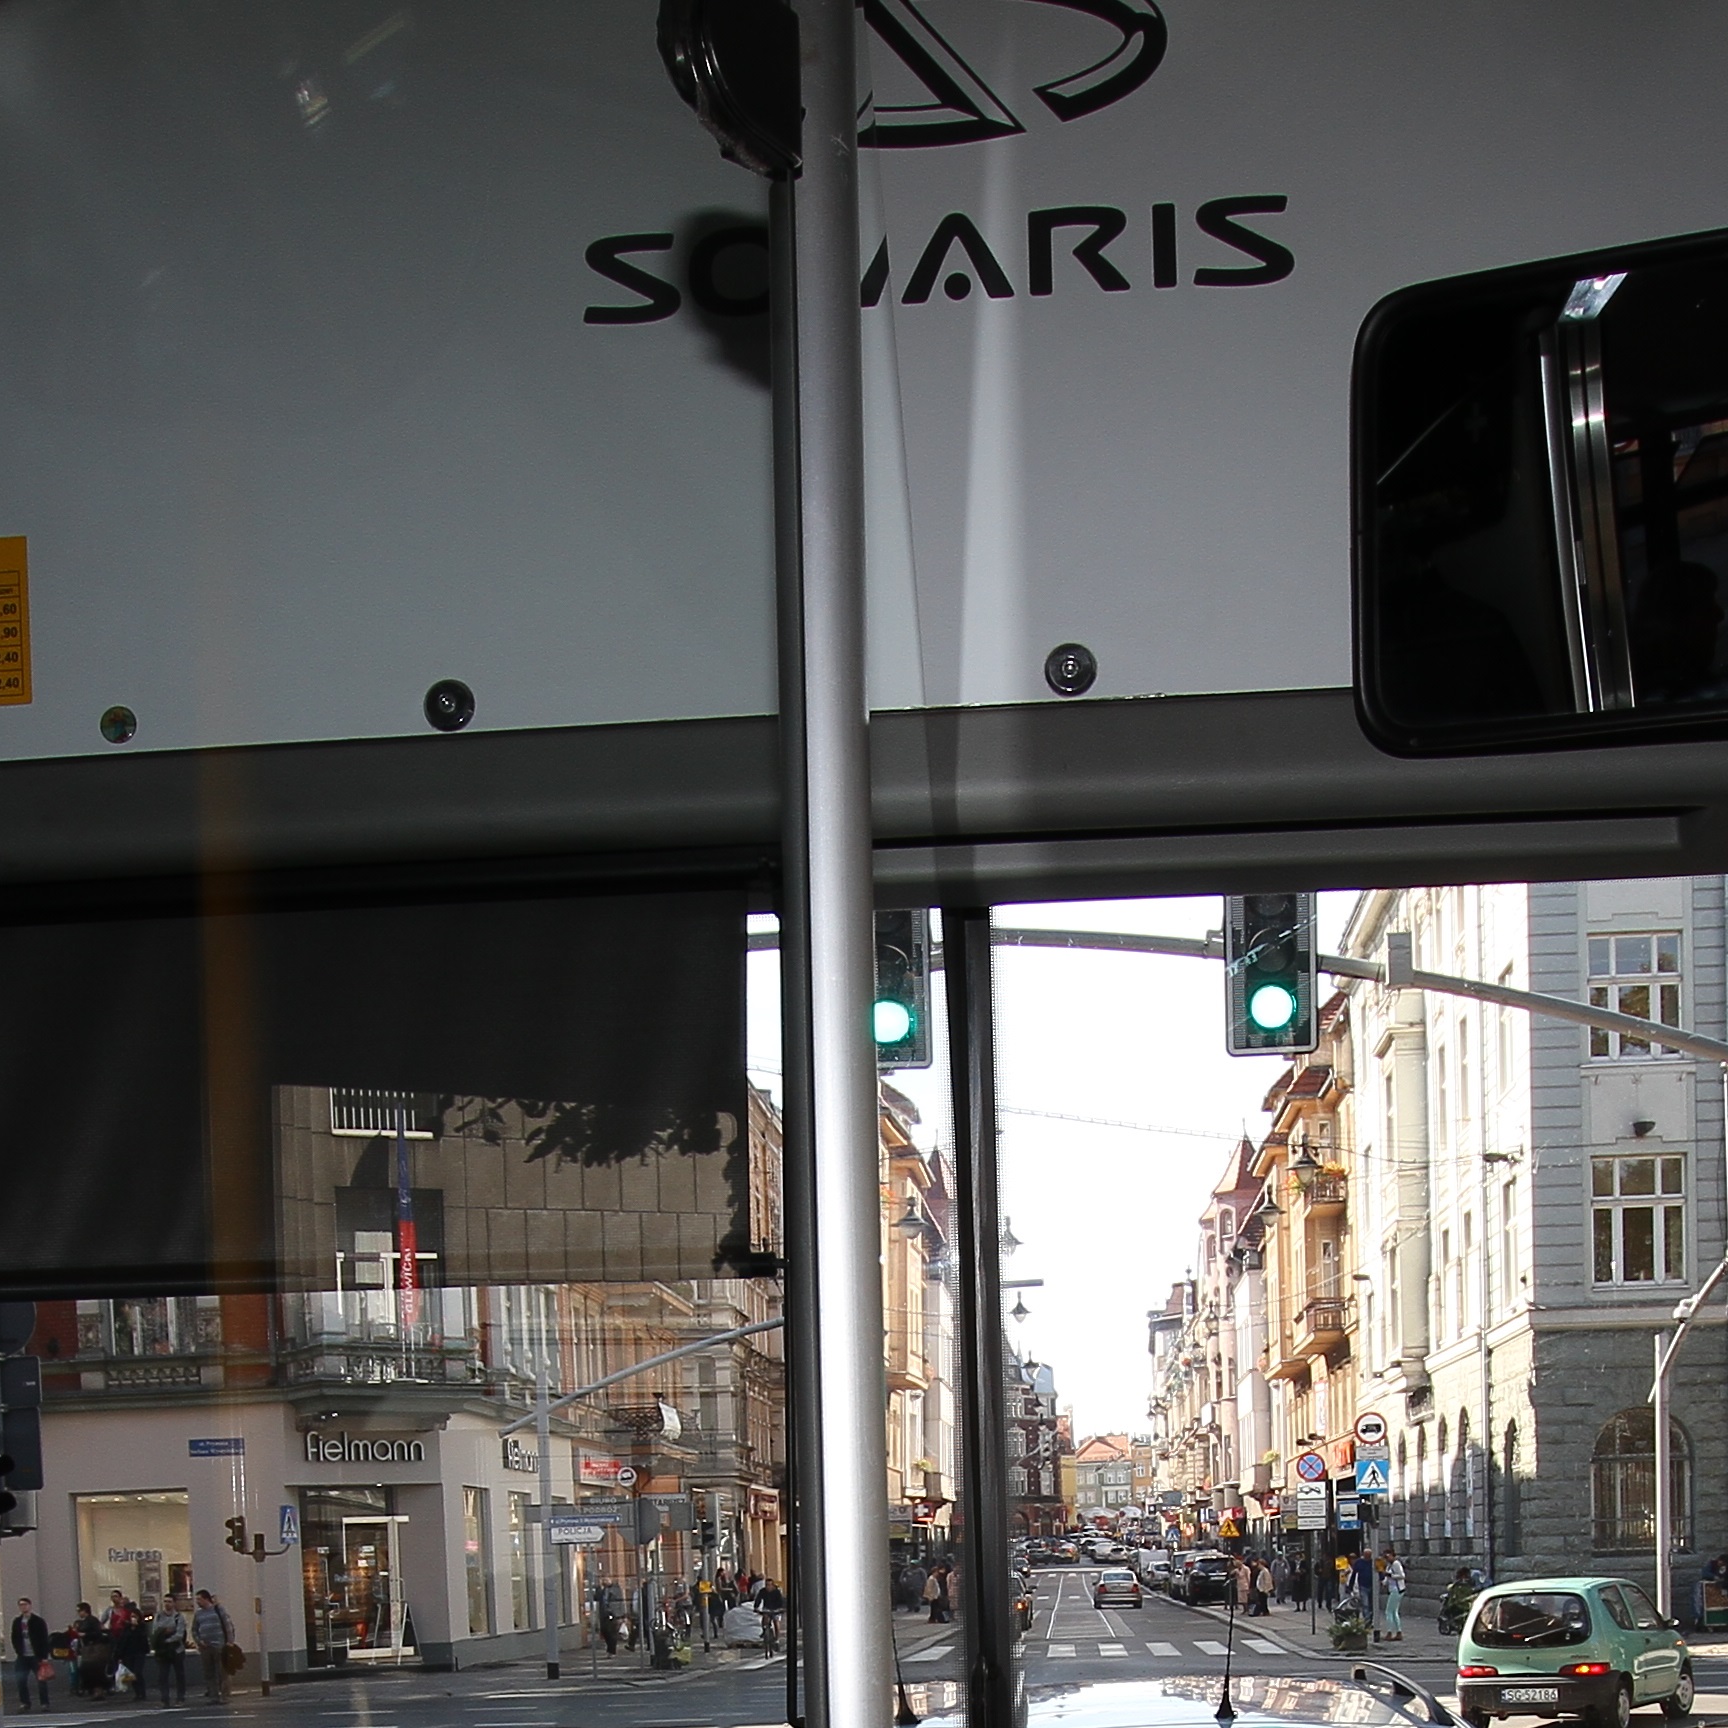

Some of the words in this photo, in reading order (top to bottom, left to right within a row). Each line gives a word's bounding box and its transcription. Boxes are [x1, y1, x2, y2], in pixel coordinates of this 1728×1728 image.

[584, 195, 1295, 324] SOARIS
[306, 1430, 425, 1462] fielmann
[558, 1528, 593, 1536] POLICJA
[1507, 1689, 1522, 1701] SG
[1524, 1689, 1557, 1702] 52186
